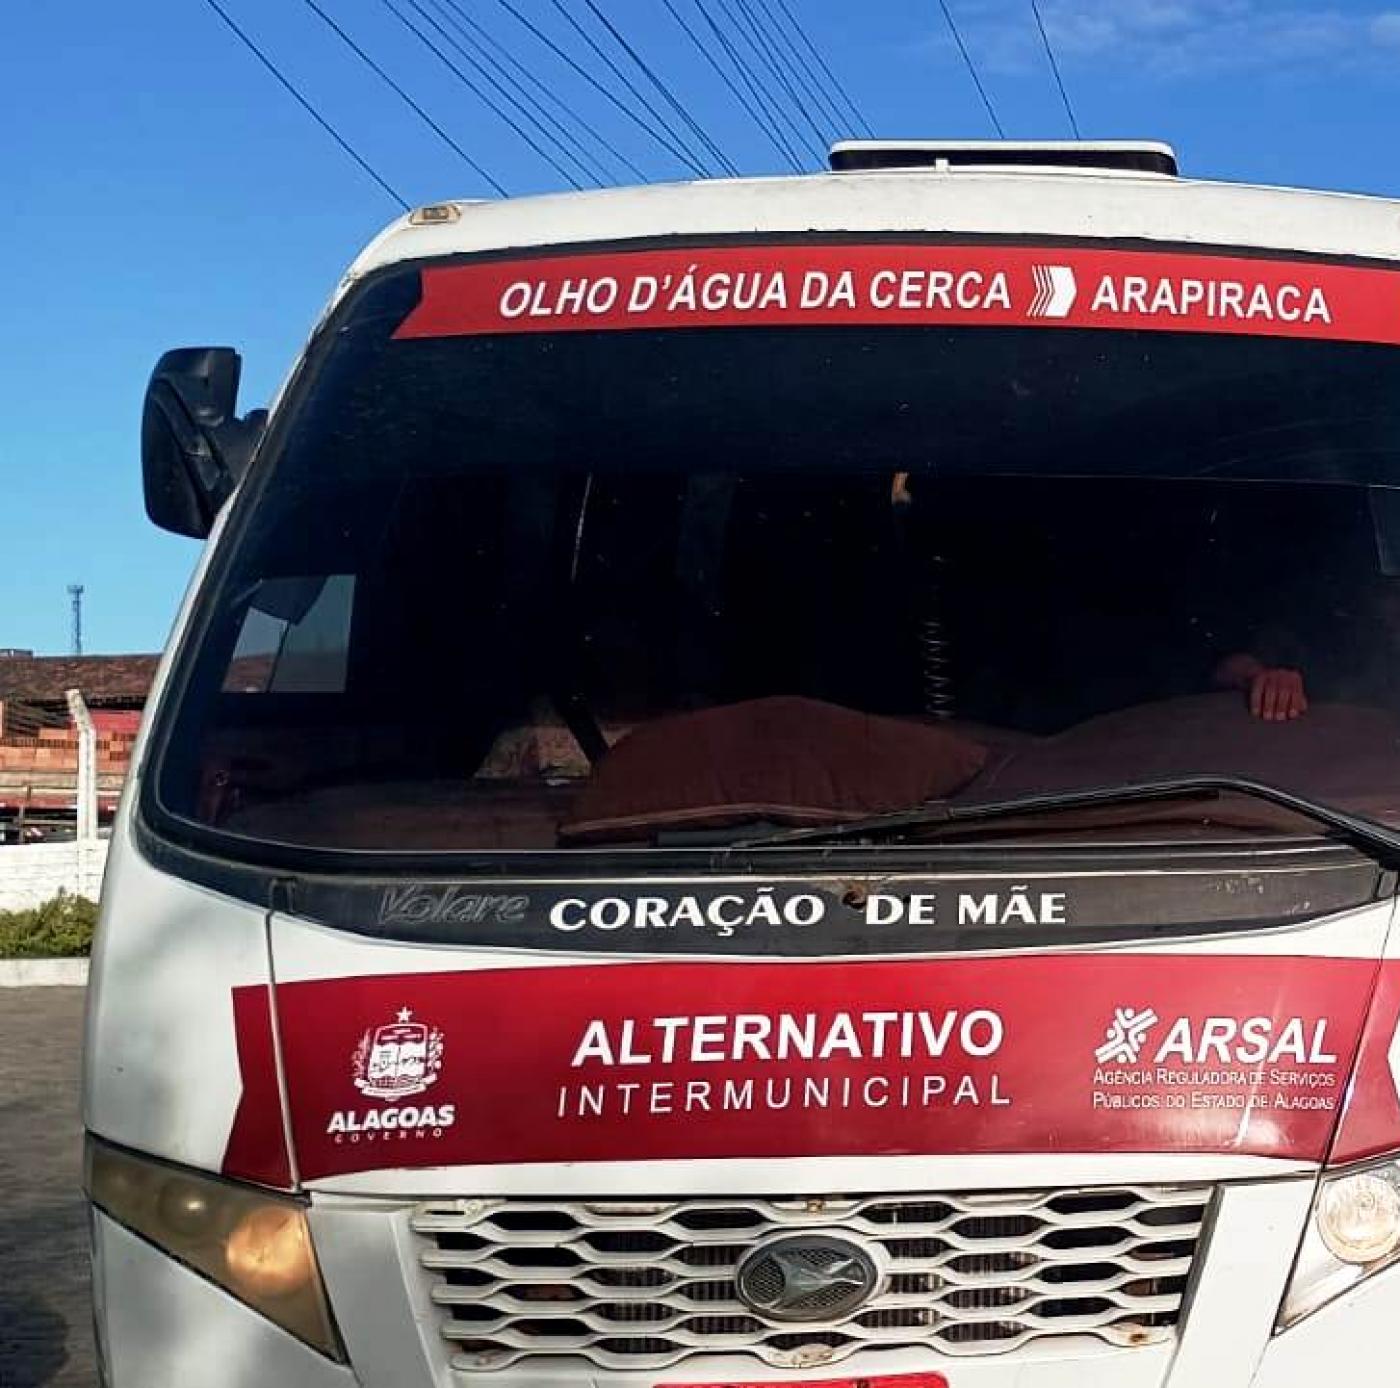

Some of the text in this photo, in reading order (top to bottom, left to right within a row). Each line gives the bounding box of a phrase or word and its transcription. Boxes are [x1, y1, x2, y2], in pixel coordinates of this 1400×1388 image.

[500, 277, 617, 317] OLHO
[800, 271, 856, 308] DA
[869, 270, 1011, 309] CERCA
[1091, 280, 1331, 323] ARAPIRACA
[549, 885, 1067, 937] CORAÇÃO DE MÃE
[571, 1010, 1004, 1067] ALTERNATIVO
[1153, 1017, 1338, 1064] ARSAL
[326, 1105, 455, 1134] ALAGOAS
[557, 1075, 1013, 1118] INTERMUNICIPAL
[1191, 1091, 1245, 1109] ESTADO
[1274, 1092, 1334, 1110] ALAGOAS
